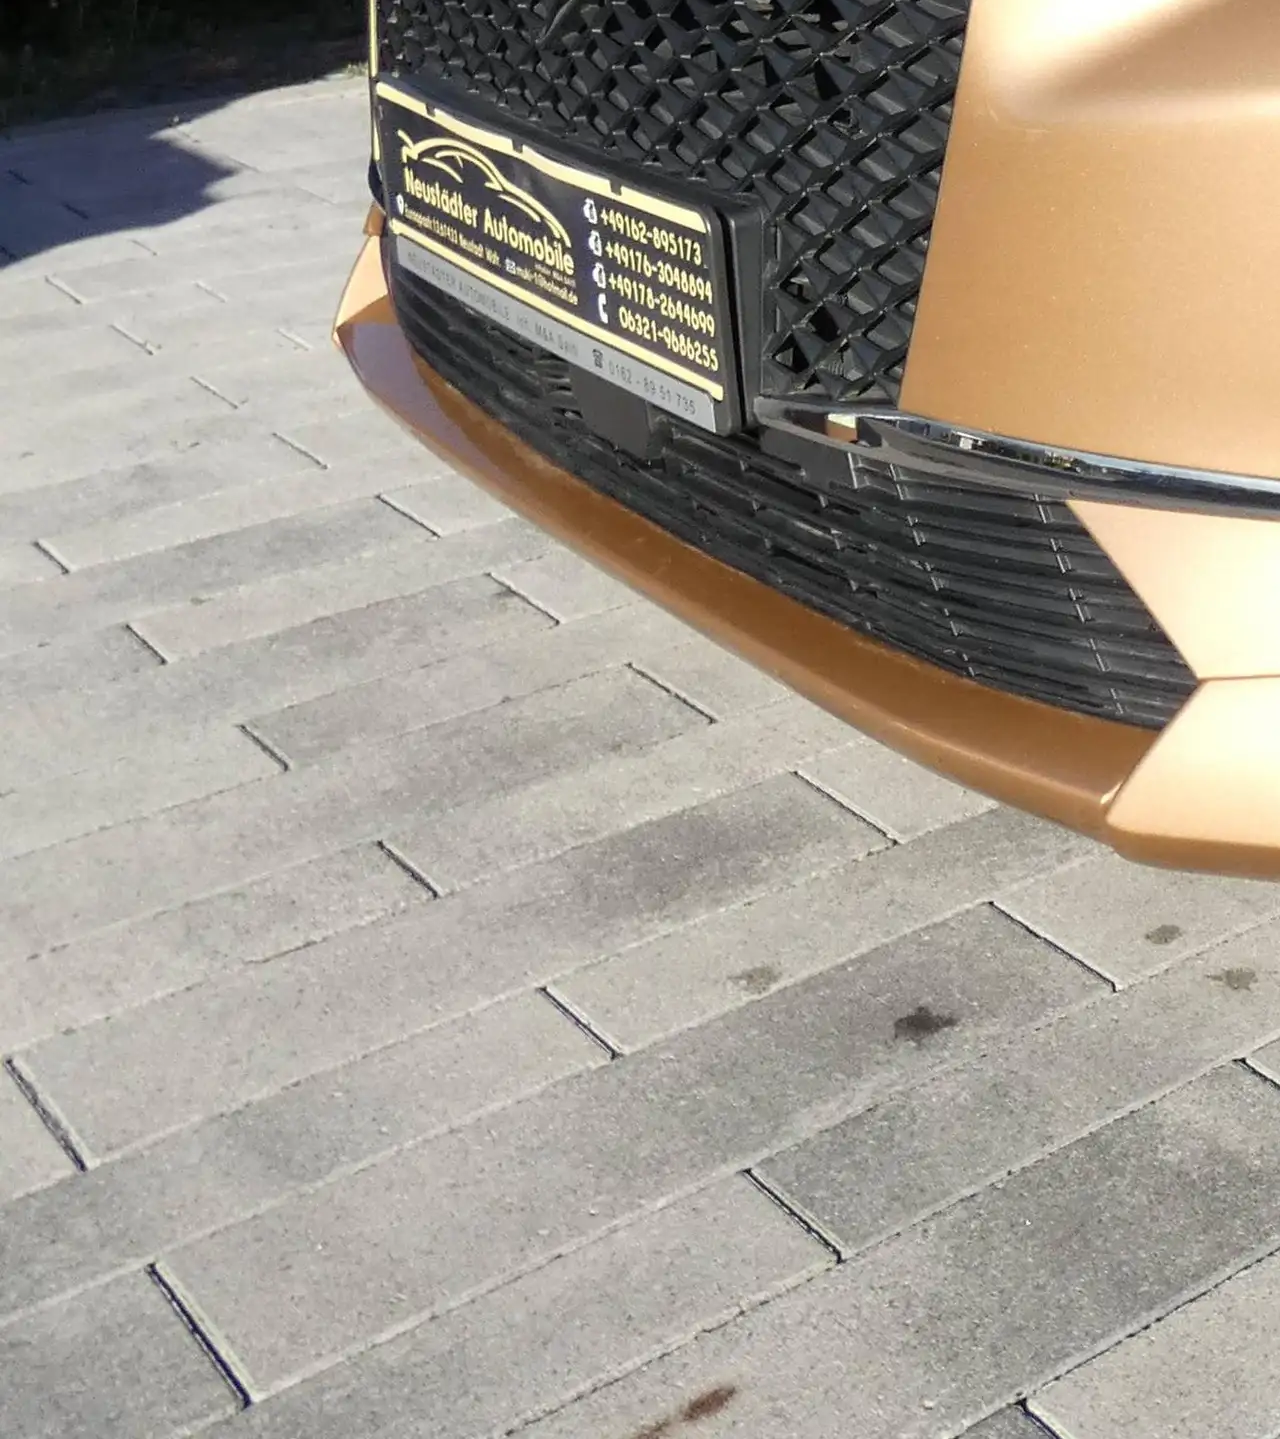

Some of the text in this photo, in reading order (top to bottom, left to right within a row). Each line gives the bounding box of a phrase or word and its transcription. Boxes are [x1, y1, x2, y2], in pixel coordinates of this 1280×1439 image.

[403, 166, 478, 228] Neustädter
[483, 207, 575, 276] Automobile
[604, 240, 713, 304] +49176-3048894
[608, 272, 715, 338] +49178-2644699
[618, 306, 719, 372] 06321-9686255
